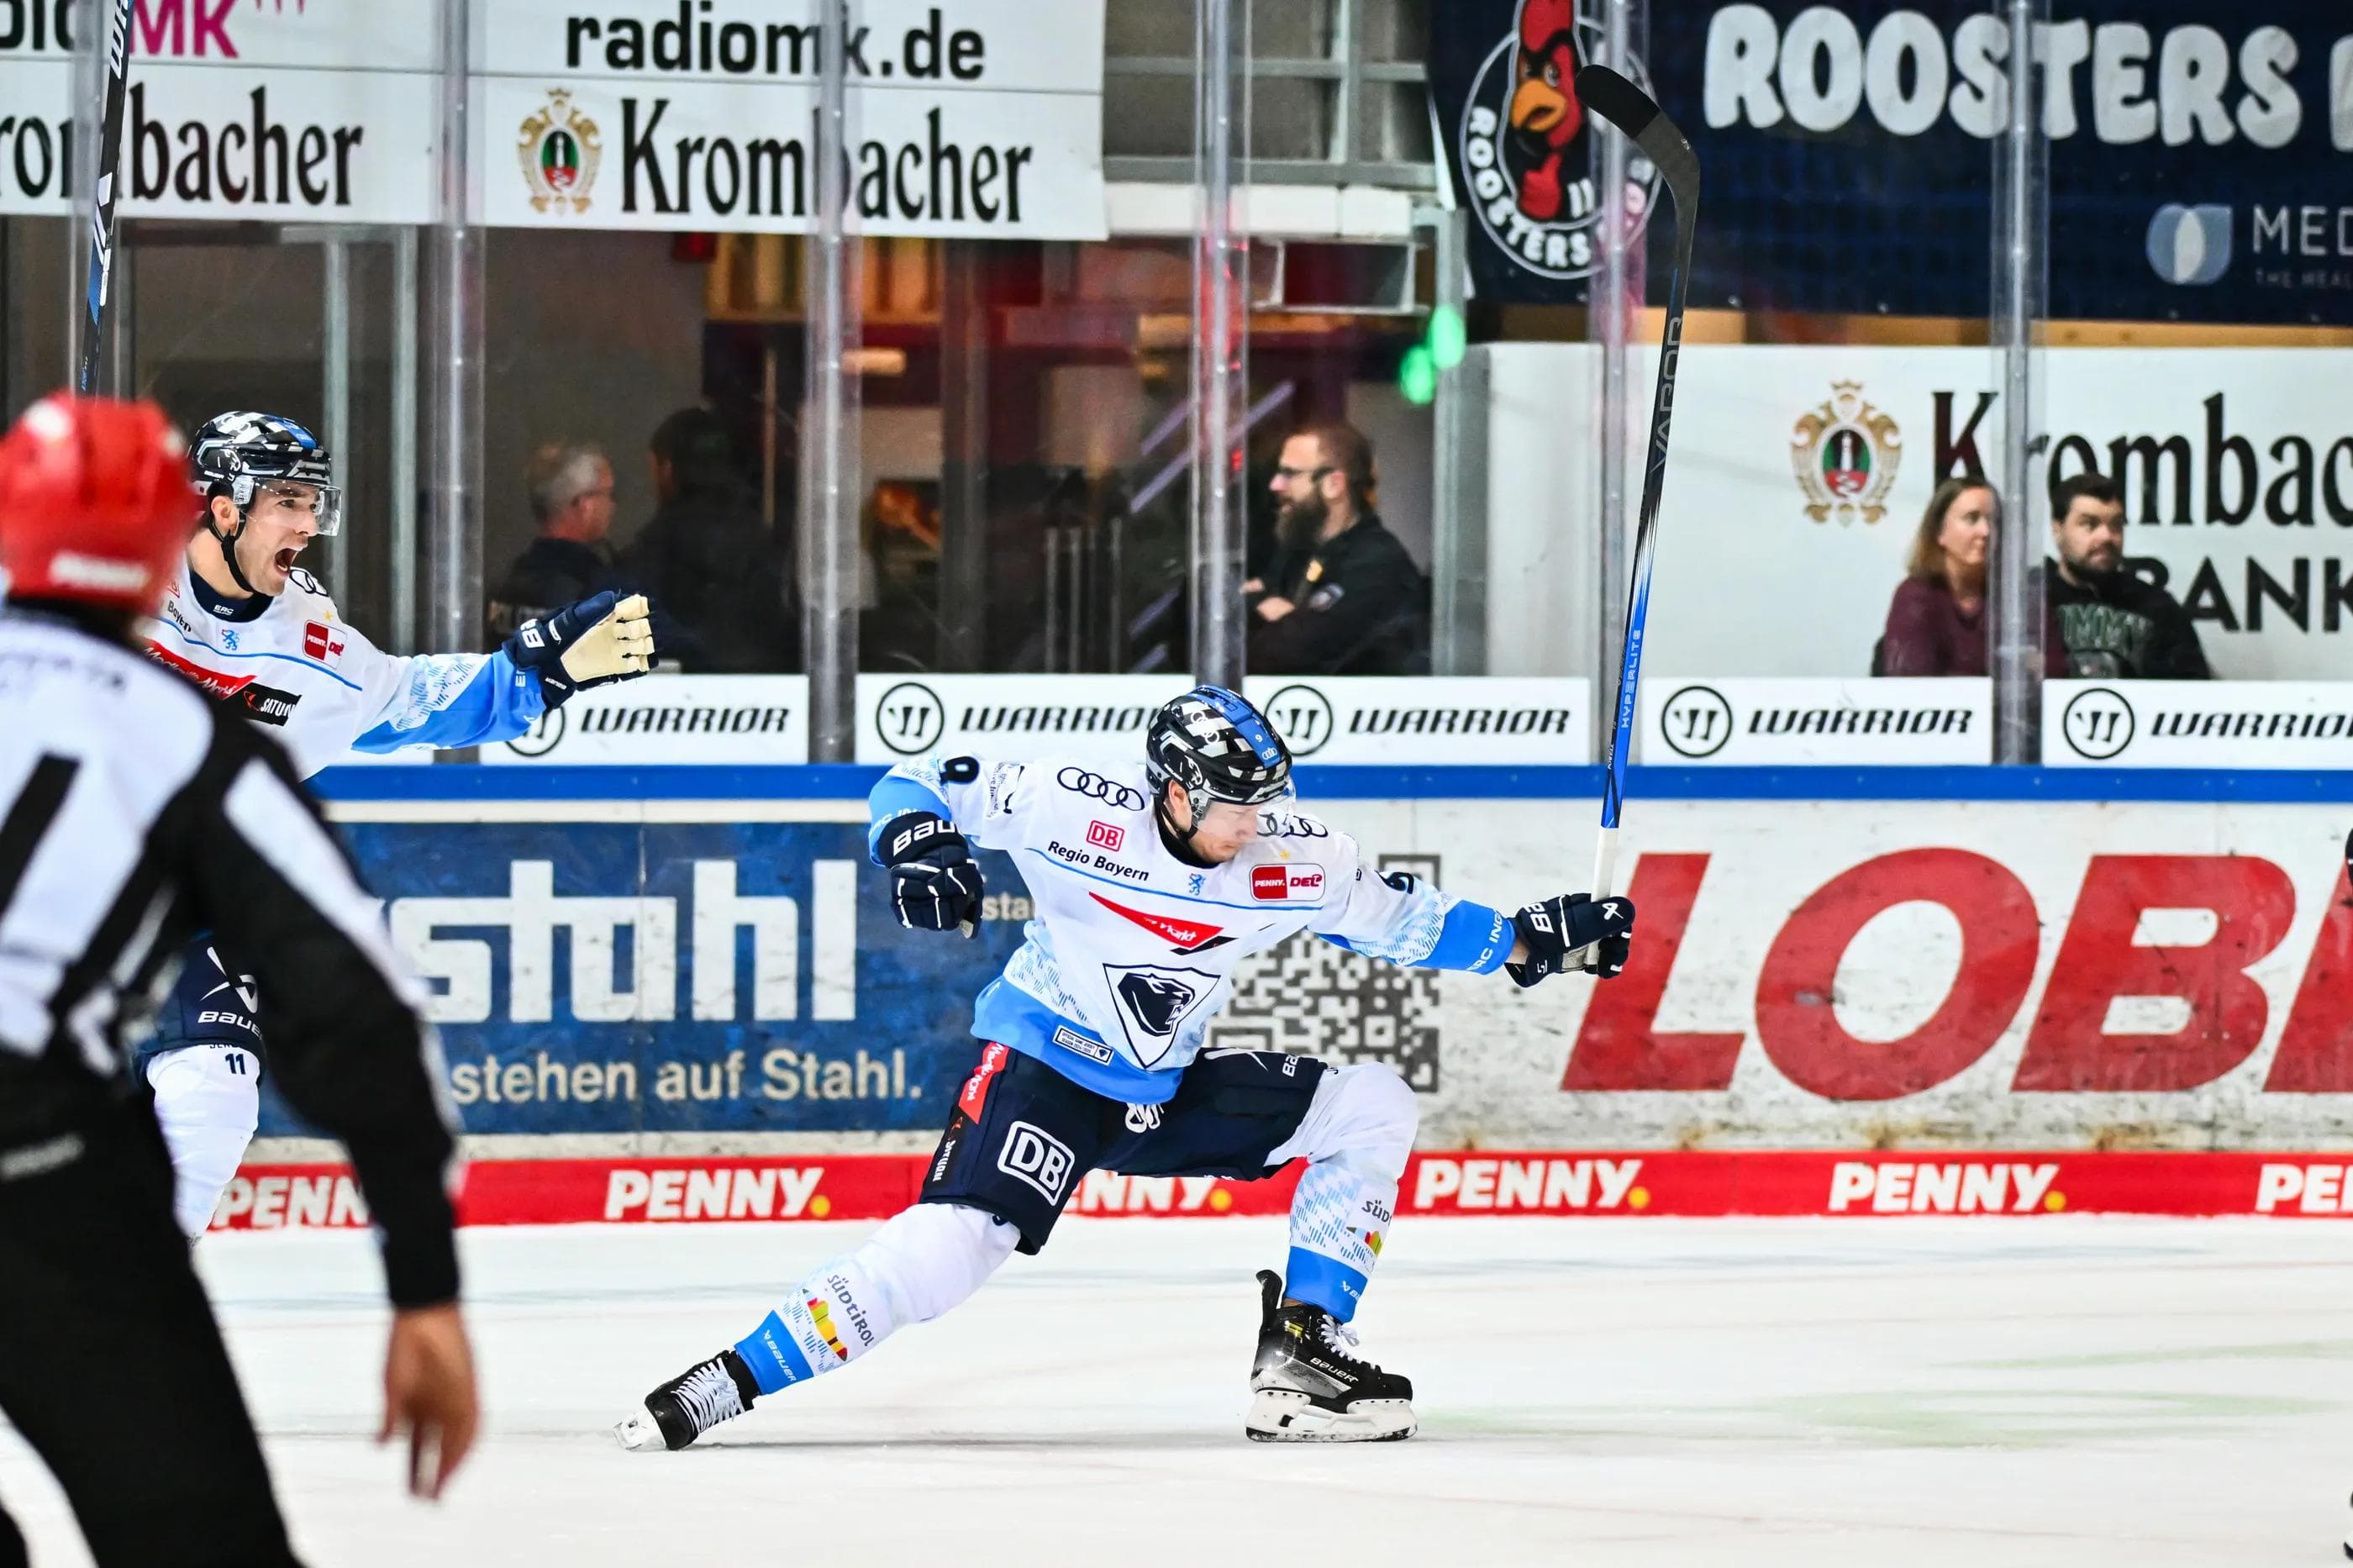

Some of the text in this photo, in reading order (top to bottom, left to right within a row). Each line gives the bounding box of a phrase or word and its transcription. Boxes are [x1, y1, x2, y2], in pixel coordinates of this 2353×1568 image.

[566, 0, 984, 79] radiomk.de
[1704, 3, 2302, 149] ROOSTERS
[580, 708, 790, 734] WARRIOR
[960, 707, 1150, 734] WARRIO
[1349, 708, 1571, 735] WARRIOR
[1748, 708, 1973, 735] WARRIOR
[892, 819, 965, 857] BAU
[1092, 823, 1120, 850] DB
[1048, 841, 1150, 881] Regio Bayern
[982, 894, 1034, 922] sta
[1488, 910, 1506, 944] ING
[197, 1010, 262, 1040] BAUE
[224, 1053, 246, 1076] 11
[451, 1047, 923, 1104] stehen auf Stahl.
[1010, 1131, 1066, 1192] DB
[212, 1176, 370, 1227] PENN
[604, 1167, 830, 1220] PENNY.
[1413, 1158, 1651, 1211] PENNY.
[1827, 1161, 2067, 1213] PENNY.
